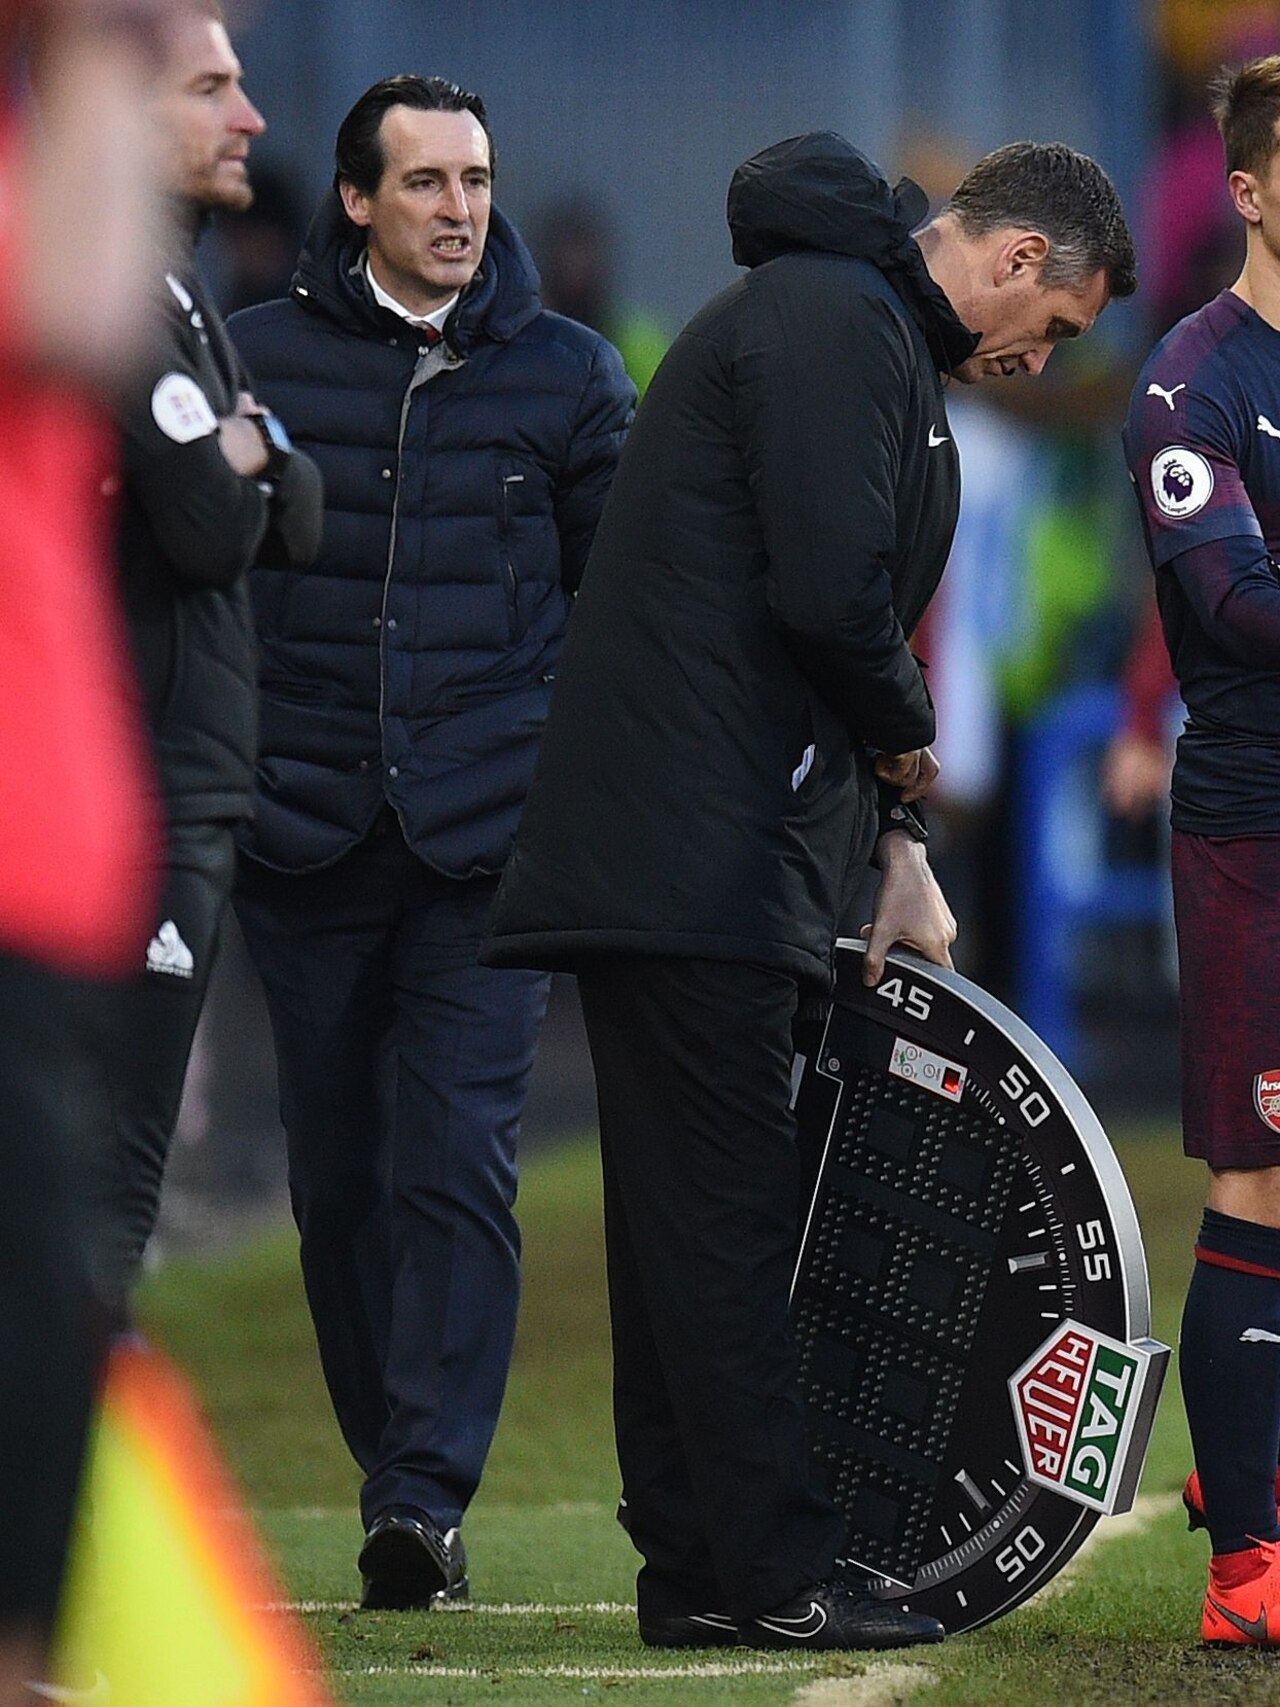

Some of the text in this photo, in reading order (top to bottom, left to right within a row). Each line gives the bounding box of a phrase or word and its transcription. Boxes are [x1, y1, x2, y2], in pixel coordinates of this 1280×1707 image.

[876, 977, 934, 1021] 45
[999, 1064, 1051, 1128] 50
[1075, 1218, 1112, 1282] 55
[1021, 1335, 1090, 1476] HEUER
[1071, 1364, 1132, 1490] TAG
[995, 1524, 1046, 1583] 05
